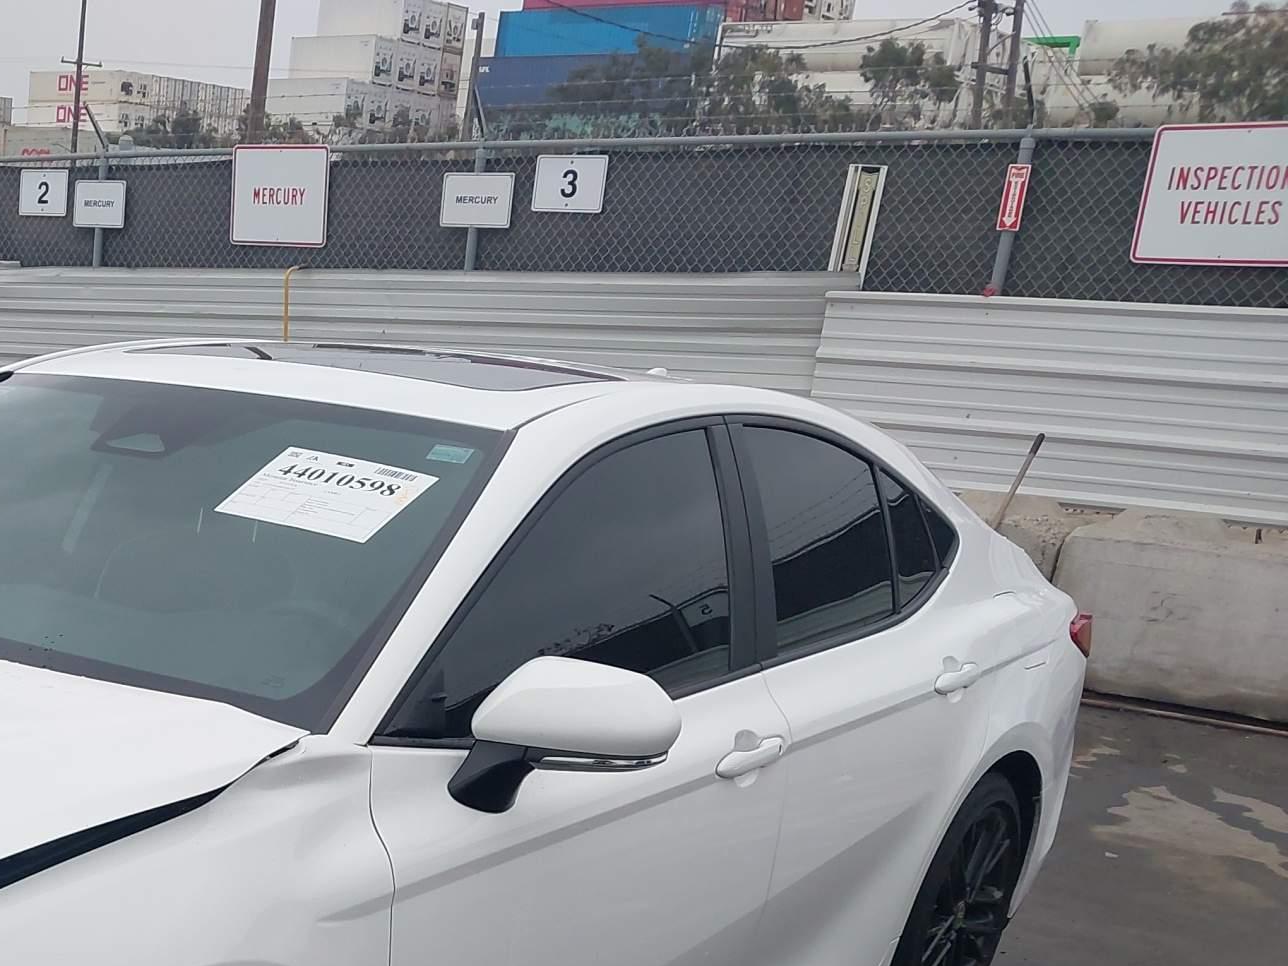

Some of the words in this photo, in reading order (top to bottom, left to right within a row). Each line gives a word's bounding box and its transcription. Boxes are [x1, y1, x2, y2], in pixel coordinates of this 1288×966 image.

[58, 75, 89, 91] ONE
[56, 106, 87, 122] ONE
[37, 181, 50, 204] 2
[560, 169, 578, 198] 3
[84, 200, 115, 208] MERCURY
[253, 187, 306, 205] MERCURY
[455, 195, 498, 205] MERCURY
[1179, 201, 1283, 225] VEHICLES
[278, 463, 402, 497] 44010598
